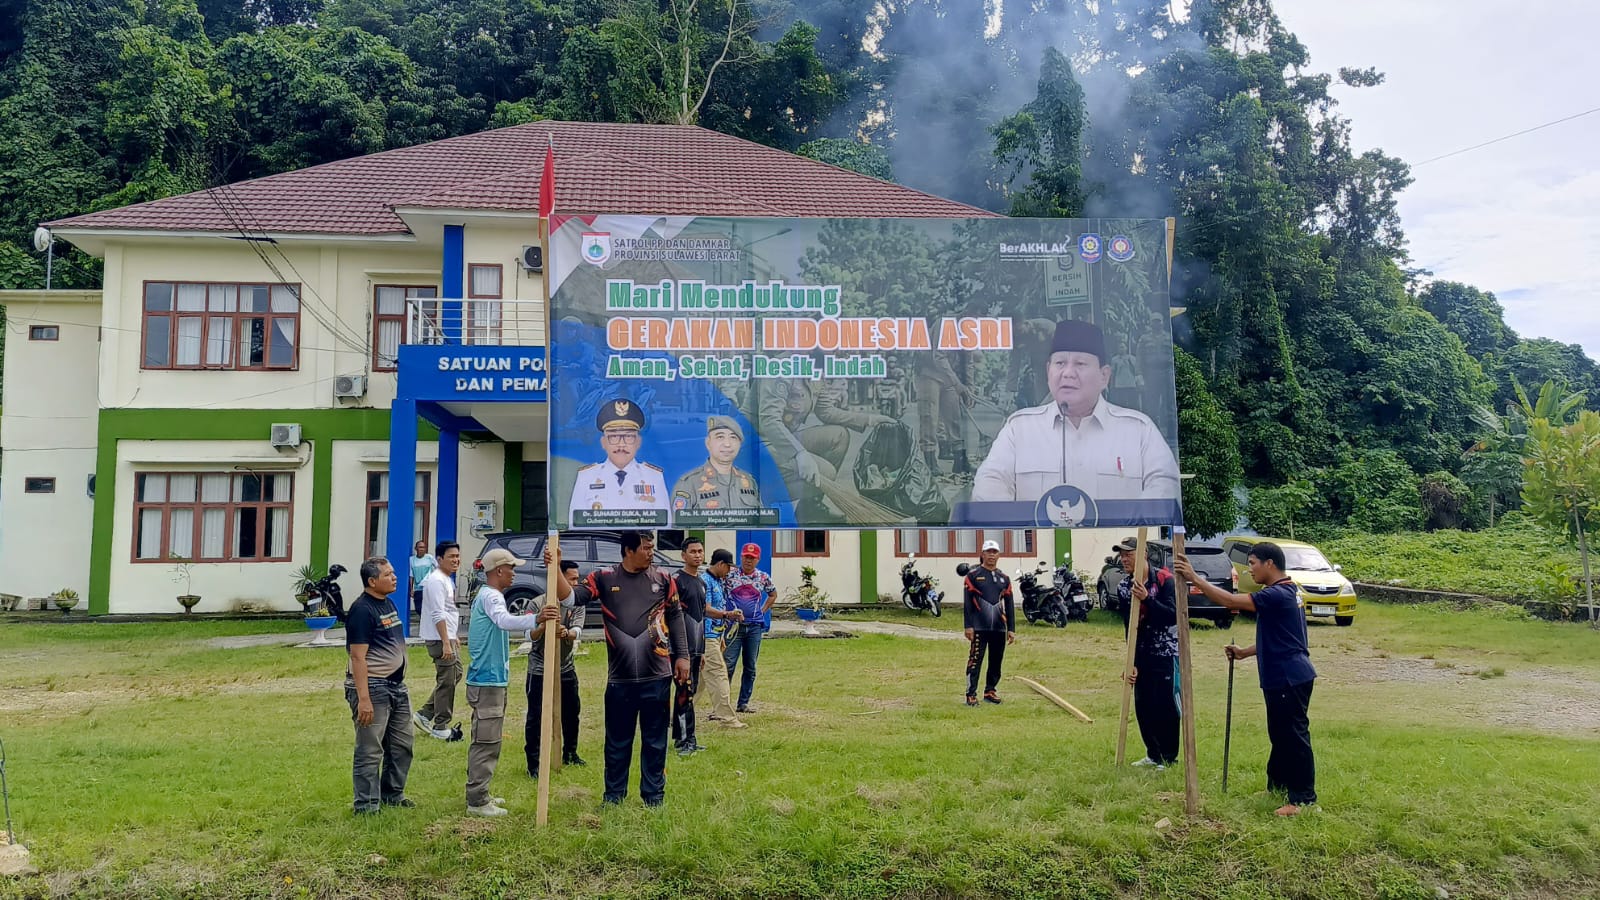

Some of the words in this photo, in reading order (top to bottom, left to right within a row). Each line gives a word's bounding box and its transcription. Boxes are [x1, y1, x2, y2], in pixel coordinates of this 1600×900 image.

[614, 238, 649, 249] SATPOL
[650, 238, 664, 249] PP
[666, 238, 688, 249] DAN
[689, 238, 730, 249] DAMKAR
[1000, 235, 1070, 254] BerAKHLAK
[614, 249, 659, 260] PROVINSI
[661, 249, 709, 260] SULAWESI
[710, 249, 741, 261] BARAT
[607, 280, 673, 309] Mari
[679, 280, 840, 316] Mendukung
[608, 317, 754, 349] GERAKAN
[763, 317, 931, 350] INDONESIA
[940, 317, 1012, 350] ASRI
[438, 357, 511, 371] SATUAN
[520, 357, 547, 371] PO
[608, 356, 675, 379] Aman,
[680, 356, 748, 379] Sehat,
[754, 356, 820, 379] Resik,
[825, 355, 885, 377] Indah
[456, 377, 494, 391] DAN
